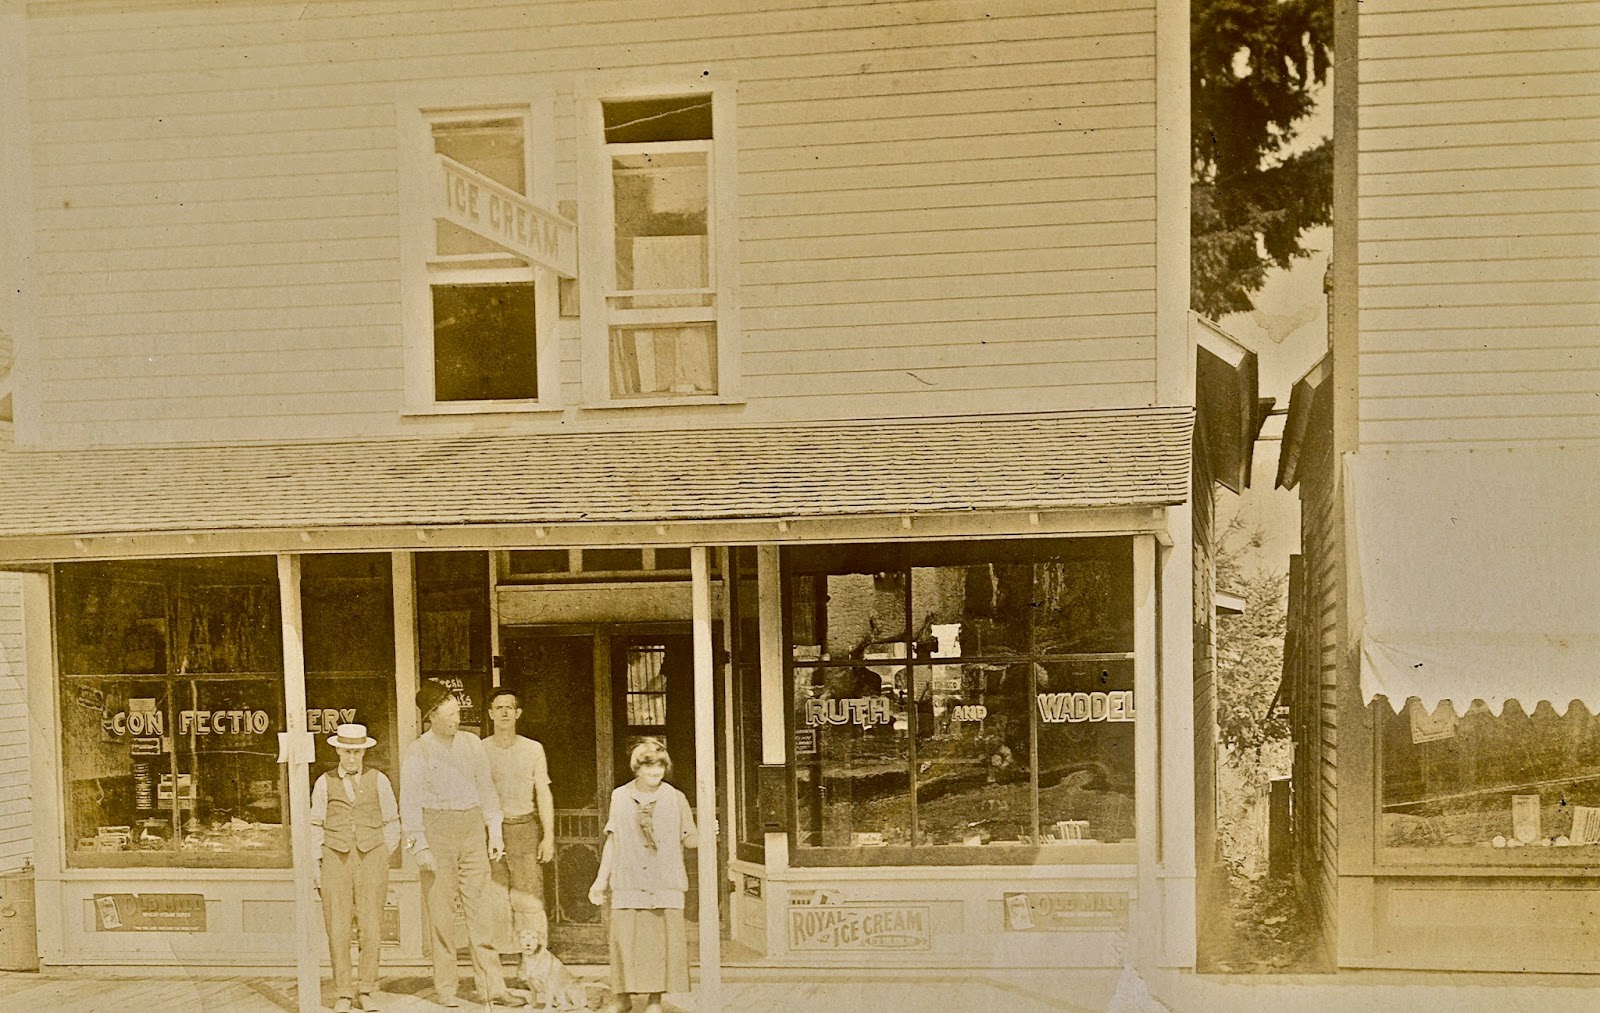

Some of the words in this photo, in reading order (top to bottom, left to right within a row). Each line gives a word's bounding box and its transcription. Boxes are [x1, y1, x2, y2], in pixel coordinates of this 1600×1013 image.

[445, 171, 479, 224] ICE
[489, 194, 560, 260] CREAM
[805, 698, 890, 725] RUTH
[951, 705, 988, 721] AND
[1039, 895, 1078, 917] OLD
[792, 911, 846, 945] ROYAL
[833, 920, 860, 947] ICE
[863, 910, 923, 935] CREAM
